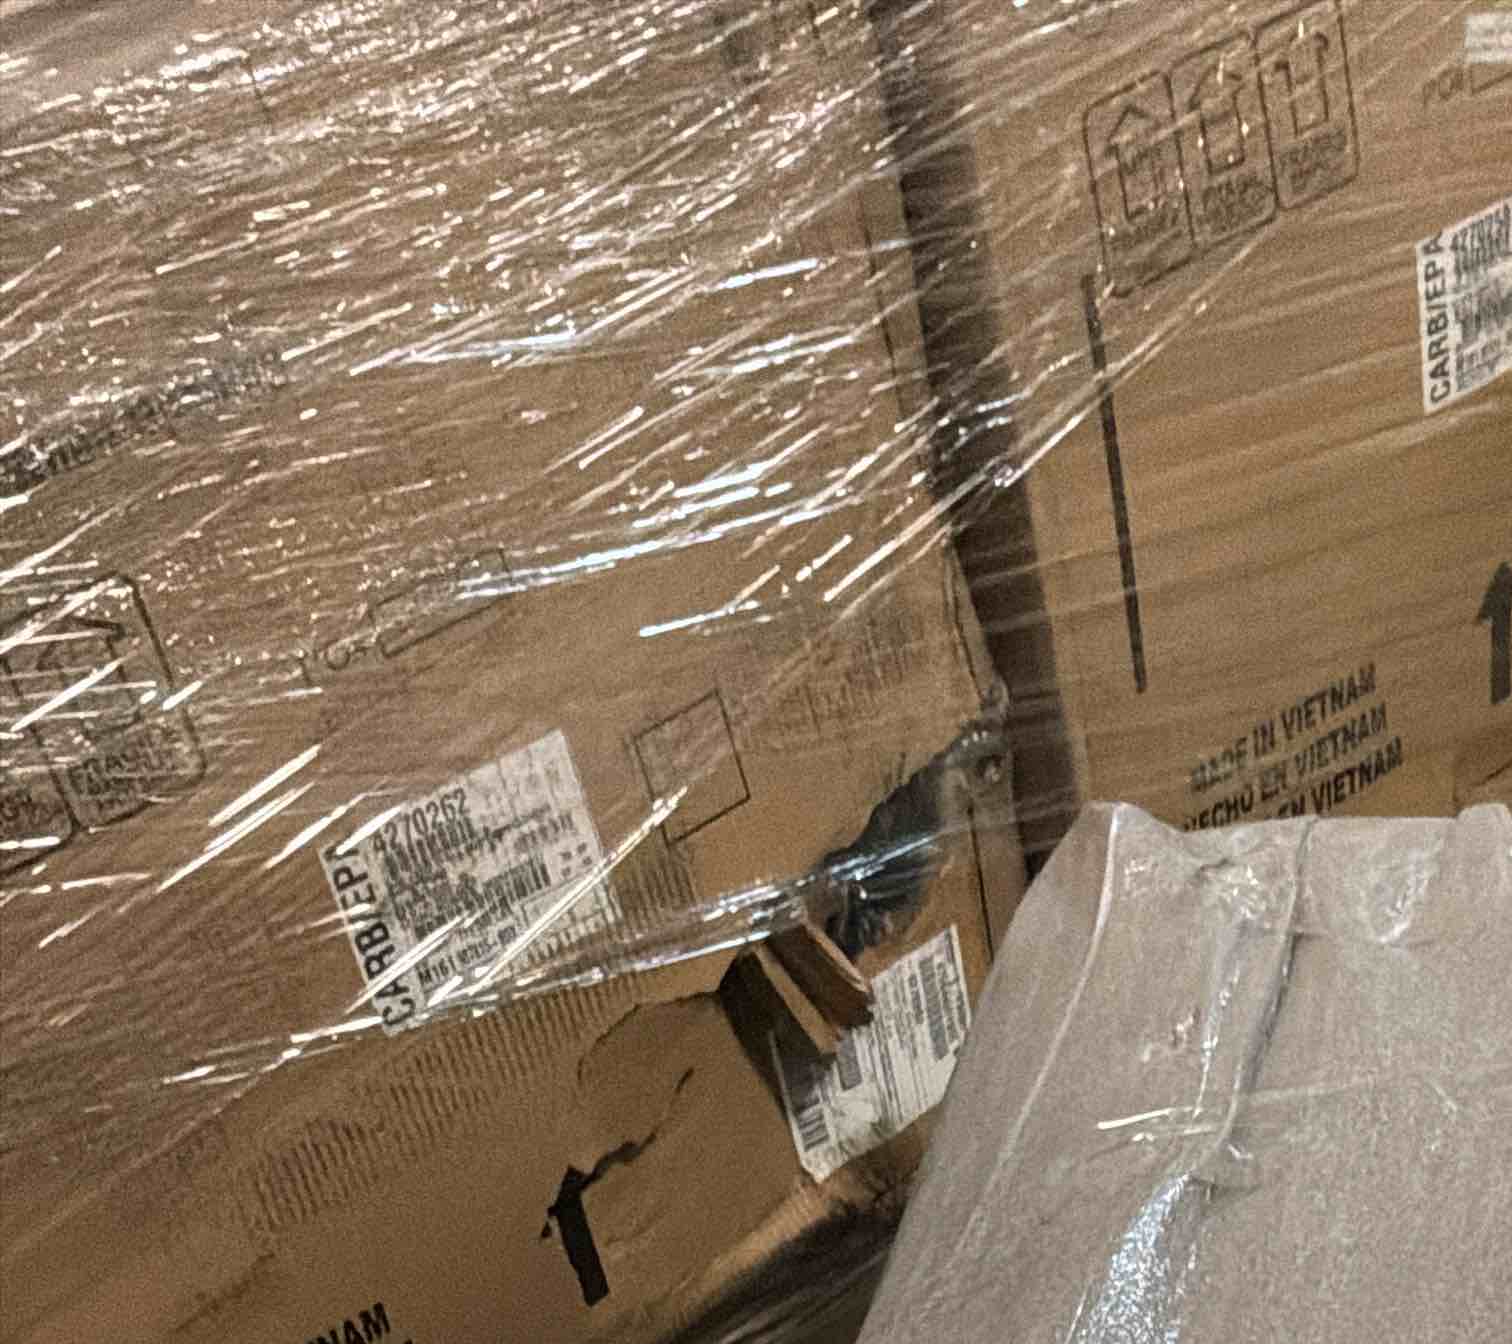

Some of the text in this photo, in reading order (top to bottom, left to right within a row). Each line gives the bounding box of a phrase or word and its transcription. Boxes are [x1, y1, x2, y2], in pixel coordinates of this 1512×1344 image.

[1251, 718, 1275, 759] IN
[1280, 661, 1376, 741] VIETNAM
[1294, 702, 1388, 776] VIETNAM
[1309, 734, 1405, 815] VIETNAM
